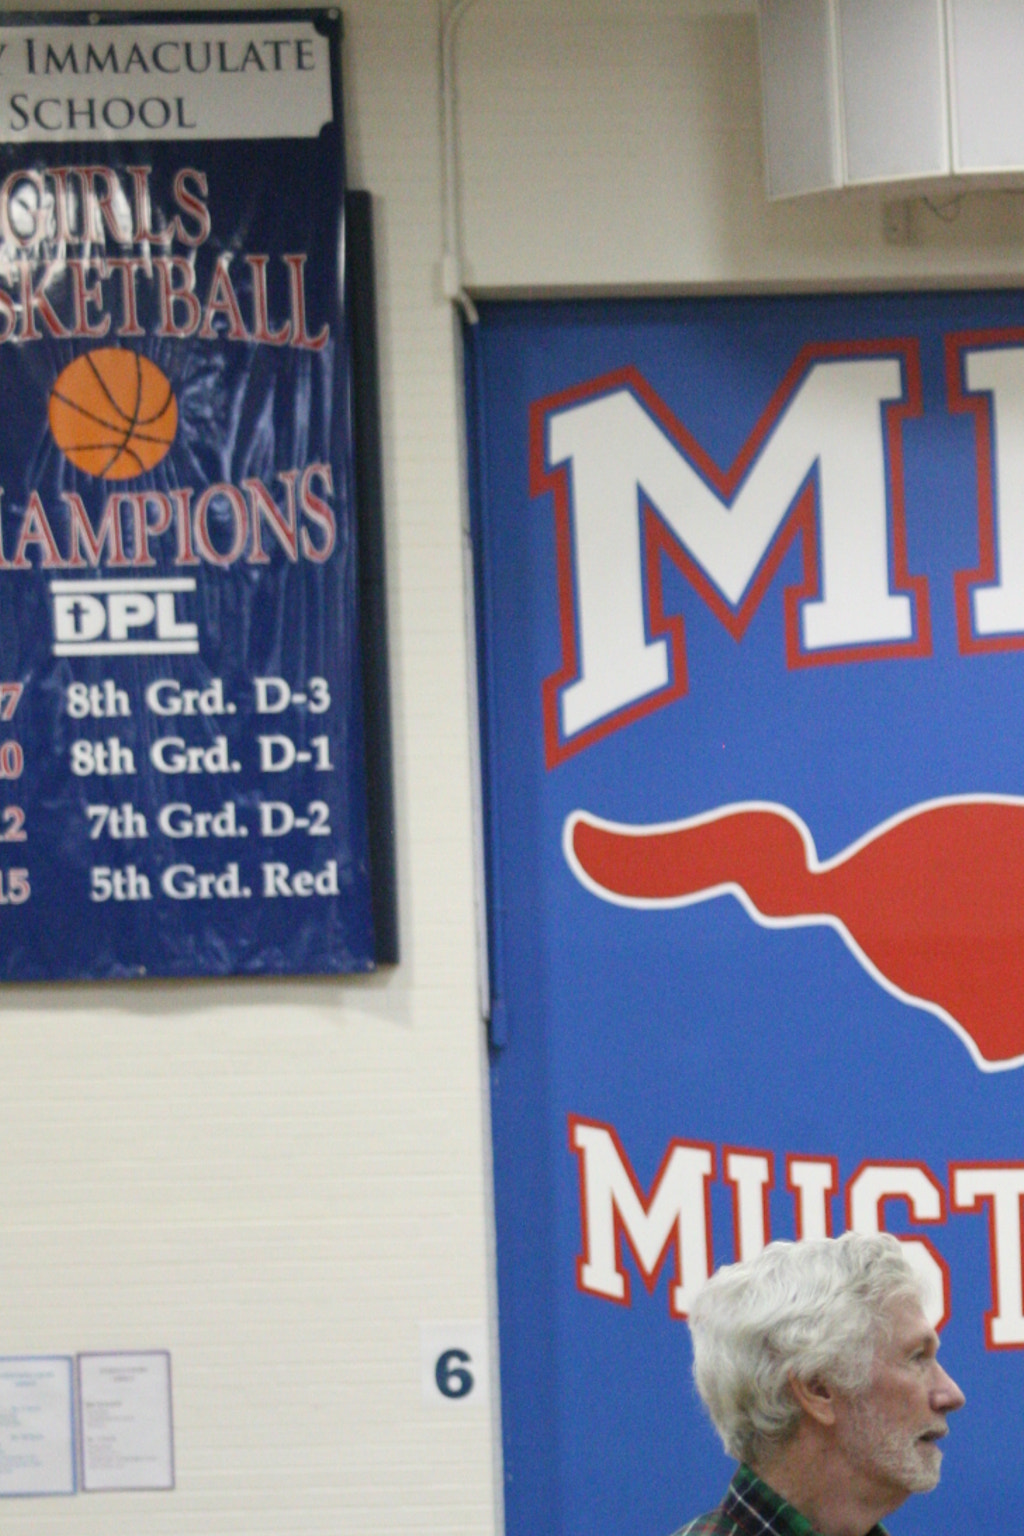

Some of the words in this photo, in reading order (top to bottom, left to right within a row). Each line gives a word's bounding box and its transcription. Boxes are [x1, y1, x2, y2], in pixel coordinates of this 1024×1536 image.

[24, 37, 316, 75] IMMACULATE
[9, 93, 197, 132] SCHOOL
[0, 165, 212, 247] GIRLS
[0, 464, 337, 570] AMPIONS
[54, 592, 199, 642] DPL
[66, 680, 131, 718] 8th
[146, 678, 237, 715] Grd.
[254, 677, 331, 712] D-3
[70, 738, 137, 777] 8th
[151, 736, 242, 775] Grd.
[259, 735, 334, 771] D-1
[86, 804, 148, 840] 7th
[157, 802, 248, 838] Grd.
[260, 802, 331, 835] D-2
[90, 866, 152, 902] 5th
[162, 863, 252, 900] Grd.
[262, 861, 340, 896] Red
[435, 1347, 475, 1400] 6
